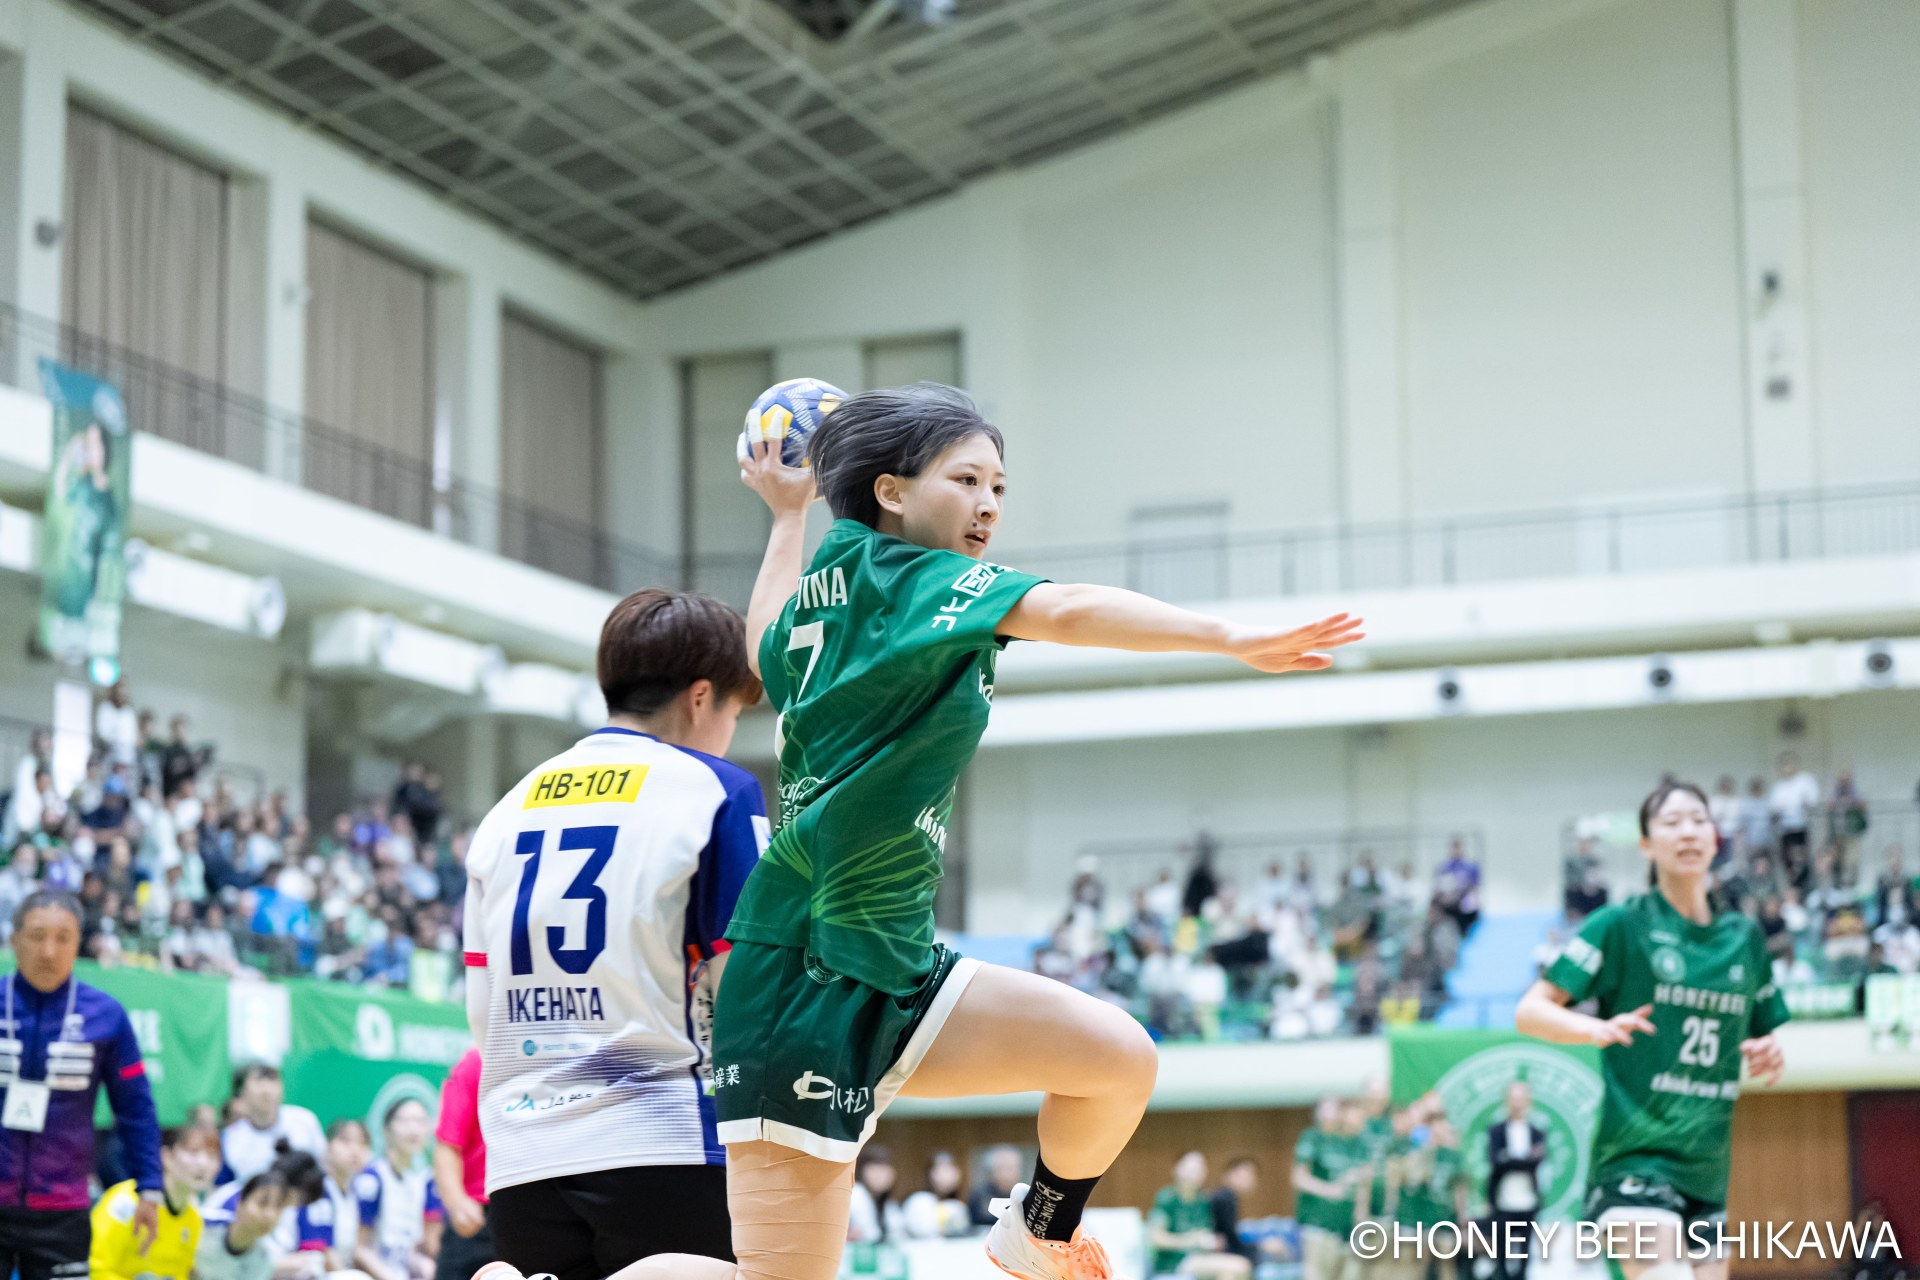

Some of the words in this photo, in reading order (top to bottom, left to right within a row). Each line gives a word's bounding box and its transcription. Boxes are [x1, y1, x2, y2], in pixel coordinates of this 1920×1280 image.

[534, 769, 632, 801] HB-101
[511, 825, 619, 976] 13
[507, 987, 605, 1023] IKEHATA
[1679, 1015, 1721, 1068] 25
[713, 1063, 741, 1089] 産業
